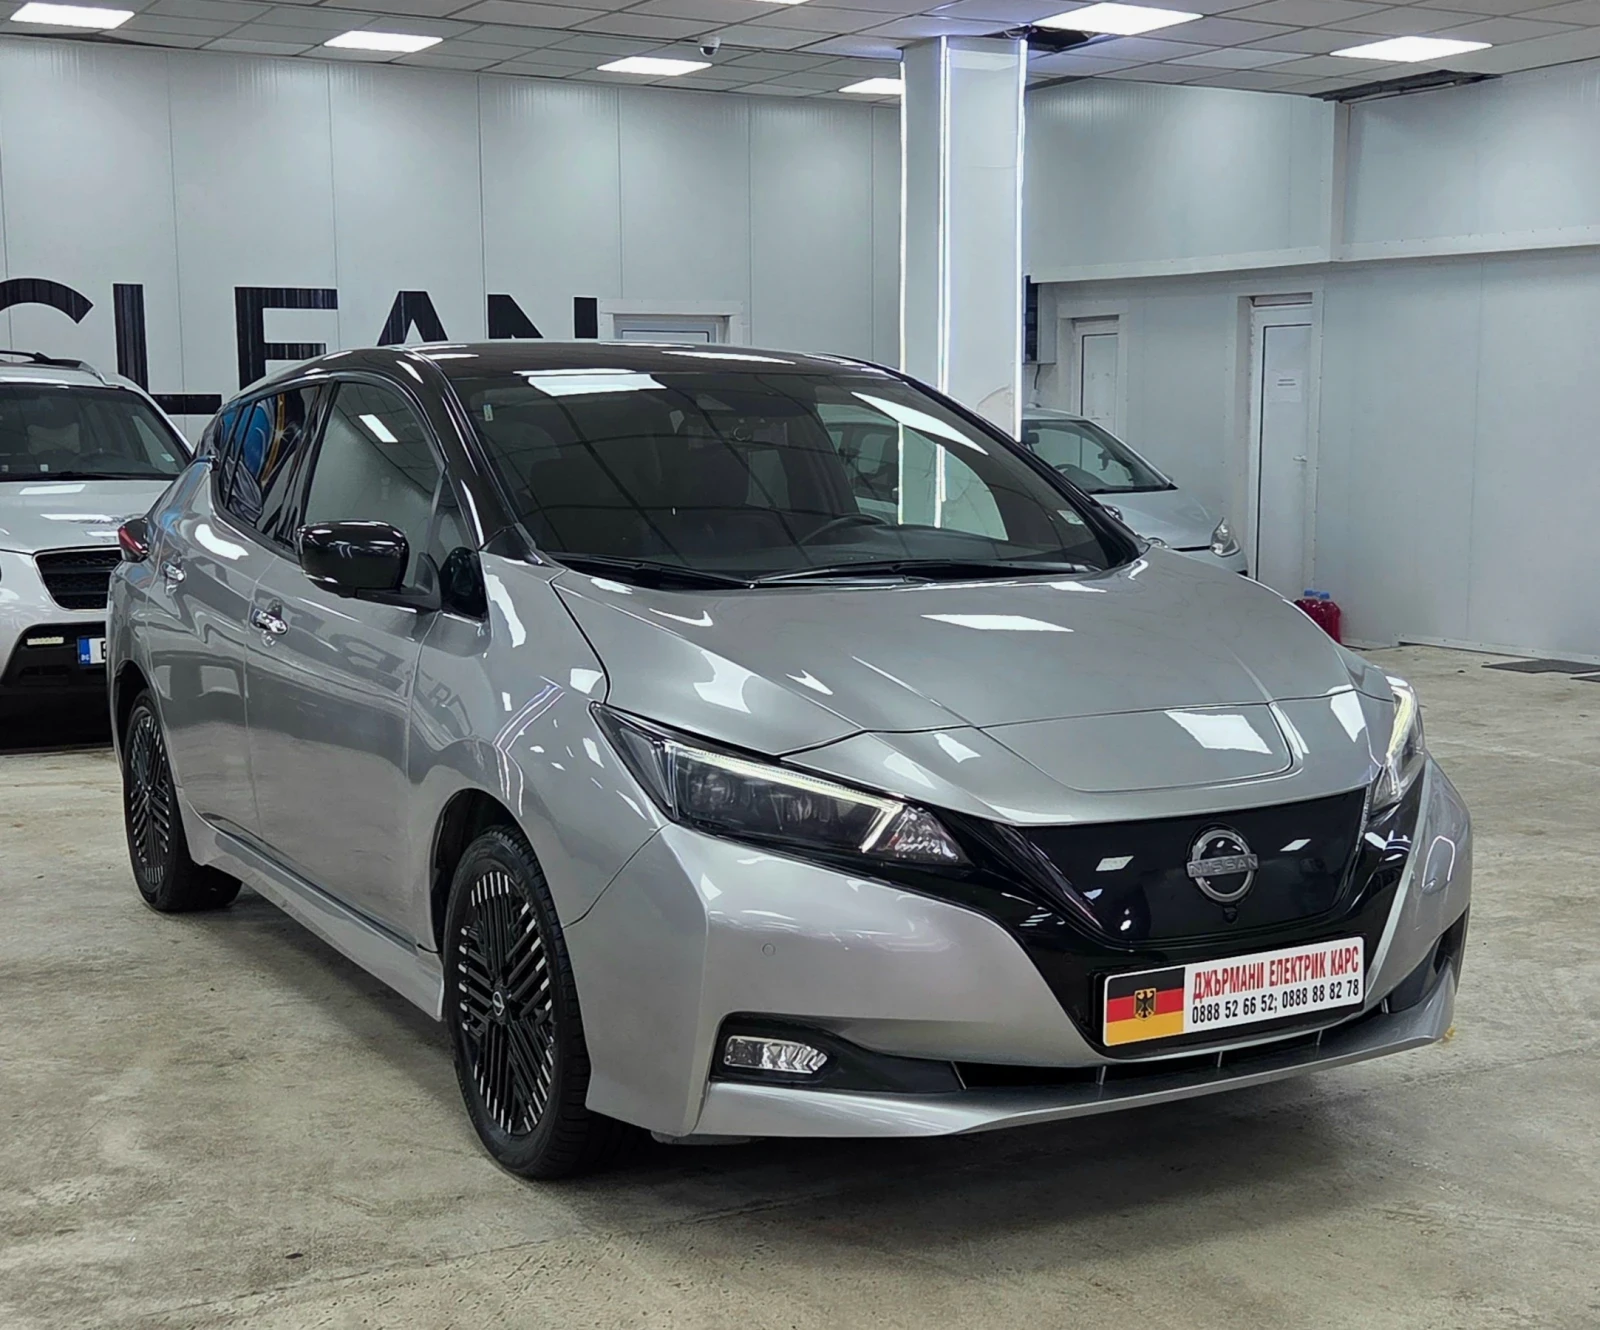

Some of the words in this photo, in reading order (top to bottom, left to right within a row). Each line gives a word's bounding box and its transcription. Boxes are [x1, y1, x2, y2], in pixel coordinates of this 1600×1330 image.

[1188, 856, 1258, 876] NISSAN
[1193, 962, 1264, 1005] ДЖЪРМАНИ
[1269, 951, 1327, 987] ЕЛЕКТРИК
[1330, 946, 1359, 976] КАРС
[1192, 1003, 1220, 1024] 0888
[1225, 1000, 1238, 1018] 52
[1243, 997, 1256, 1015] 66
[1261, 993, 1278, 1014] 52;
[1282, 988, 1308, 1008] 0888
[1312, 984, 1325, 1003] 88
[1329, 981, 1342, 1000] 82
[1347, 979, 1359, 997] 78
